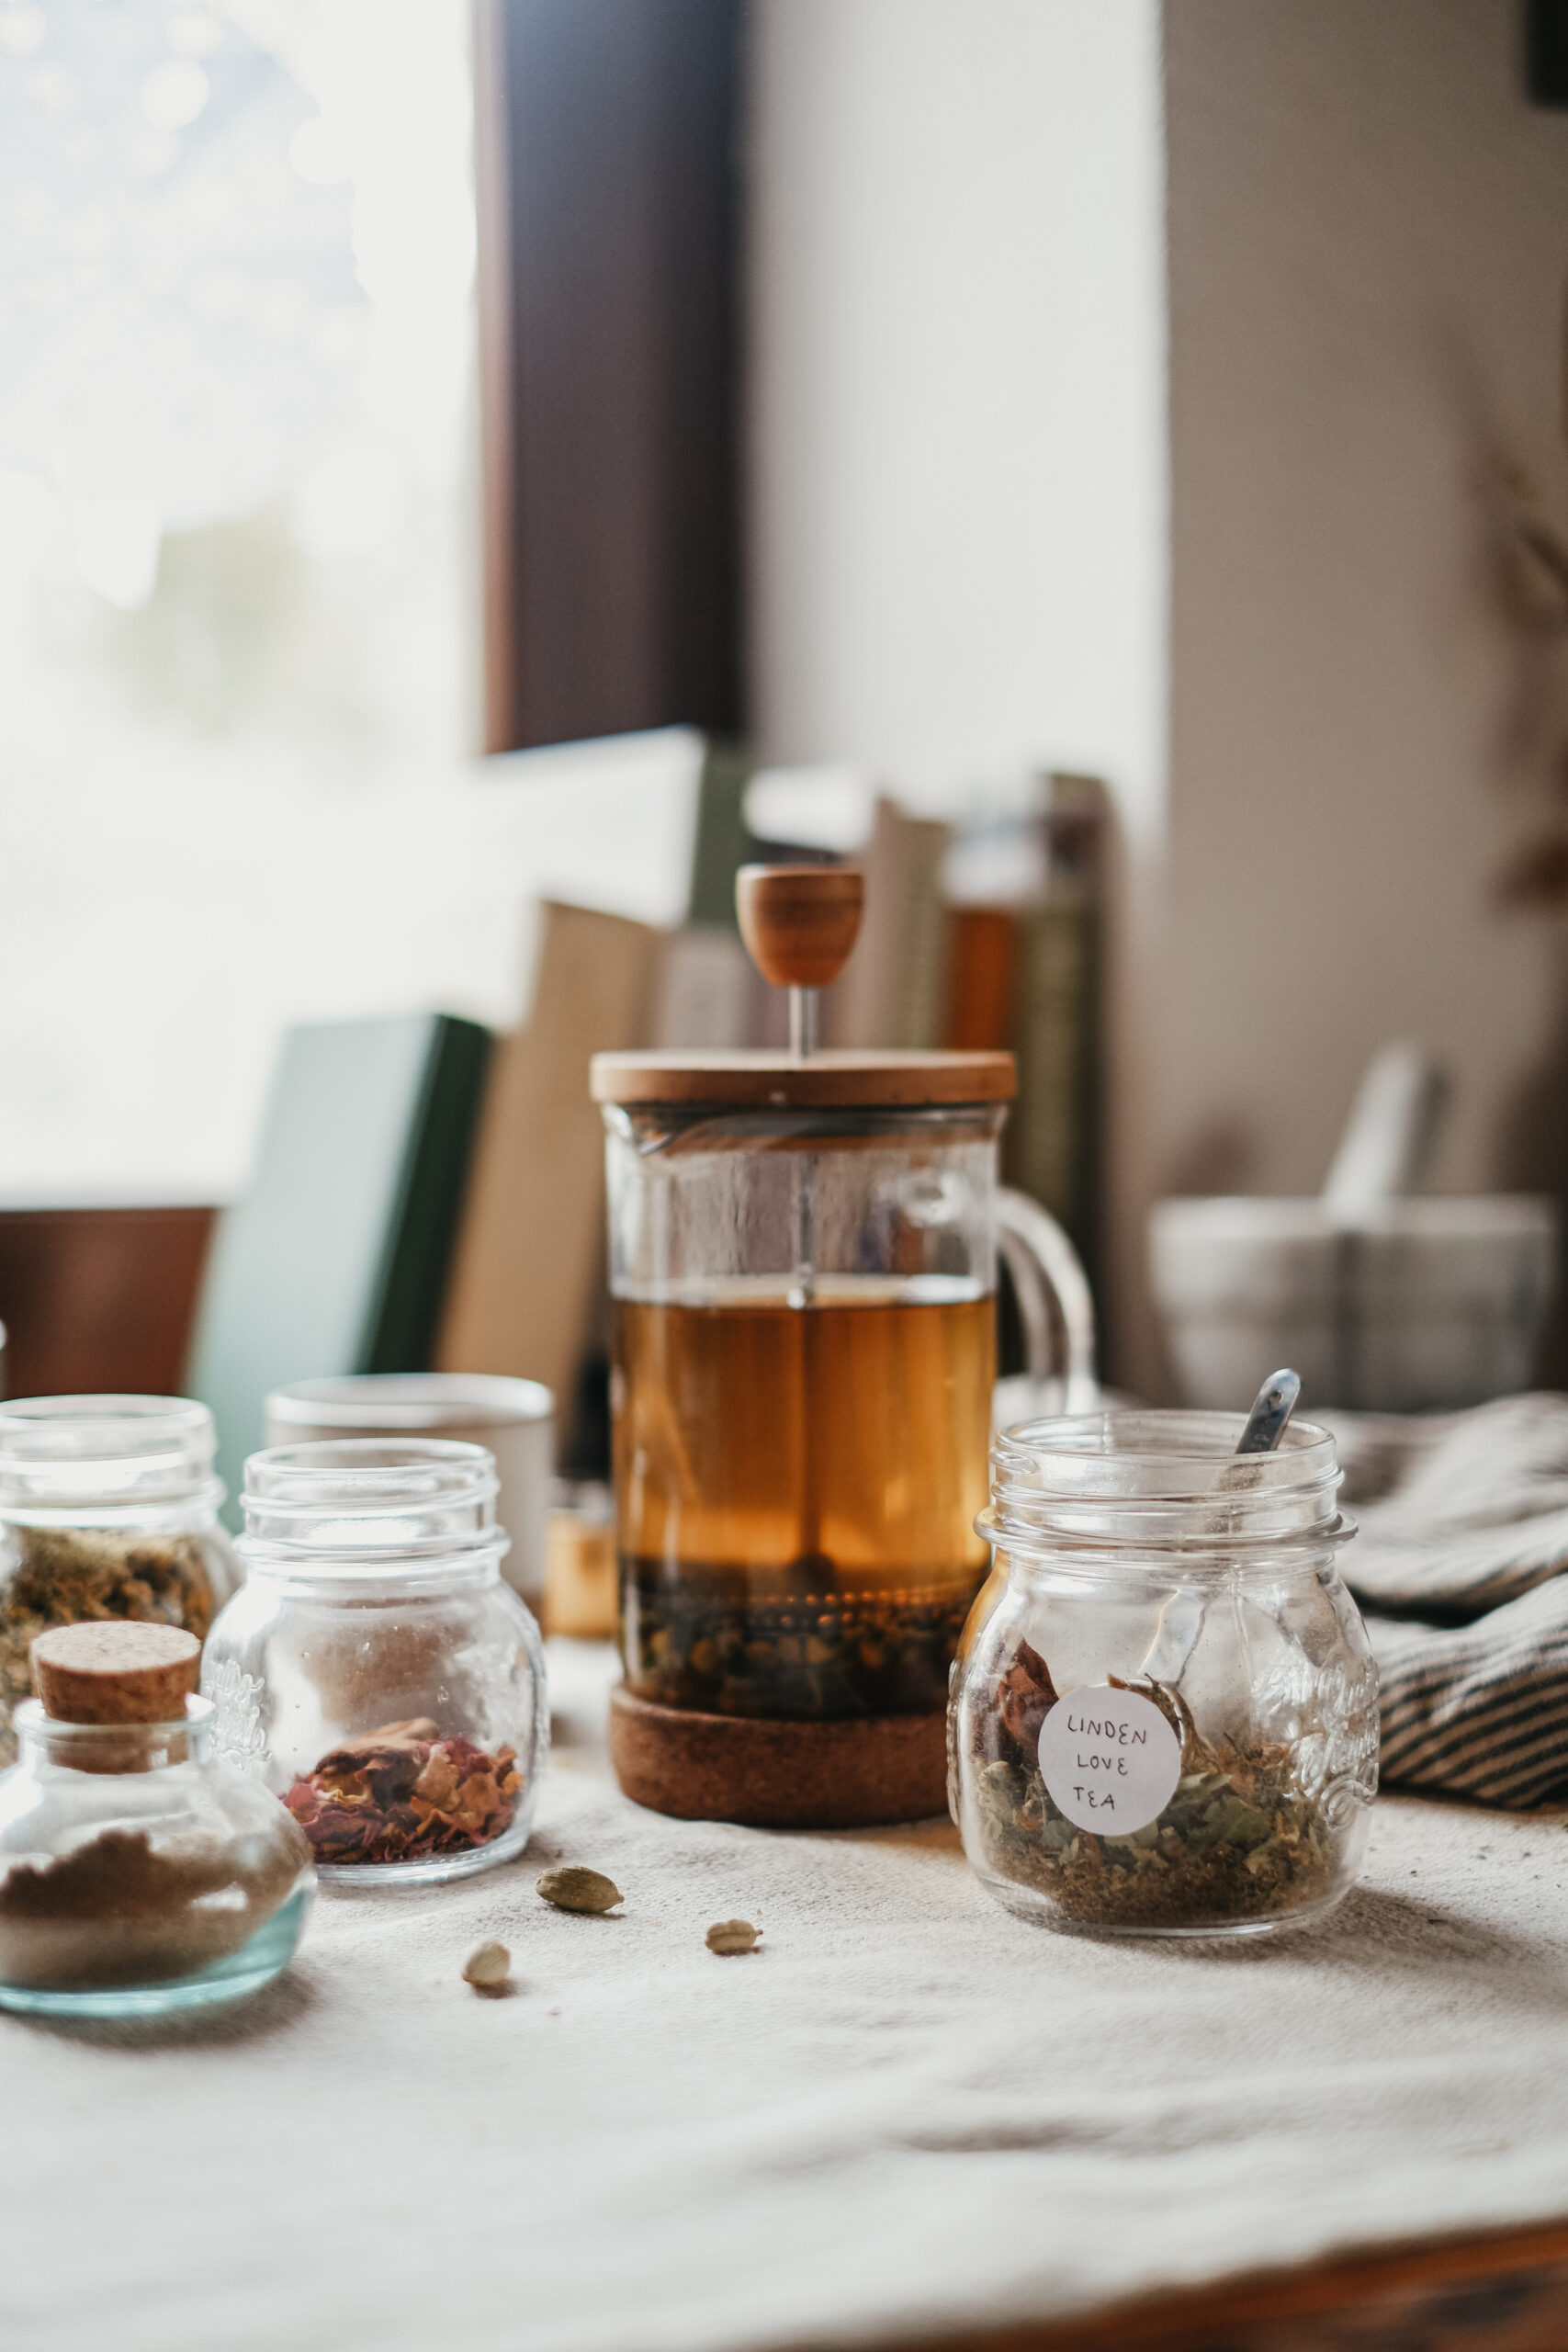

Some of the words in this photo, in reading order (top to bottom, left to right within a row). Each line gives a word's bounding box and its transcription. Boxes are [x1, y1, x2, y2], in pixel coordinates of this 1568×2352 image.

[1066, 1714, 1147, 1745] LINDEN
[1077, 1754, 1128, 1775] LOVE
[1073, 1786, 1115, 1810] TEA
